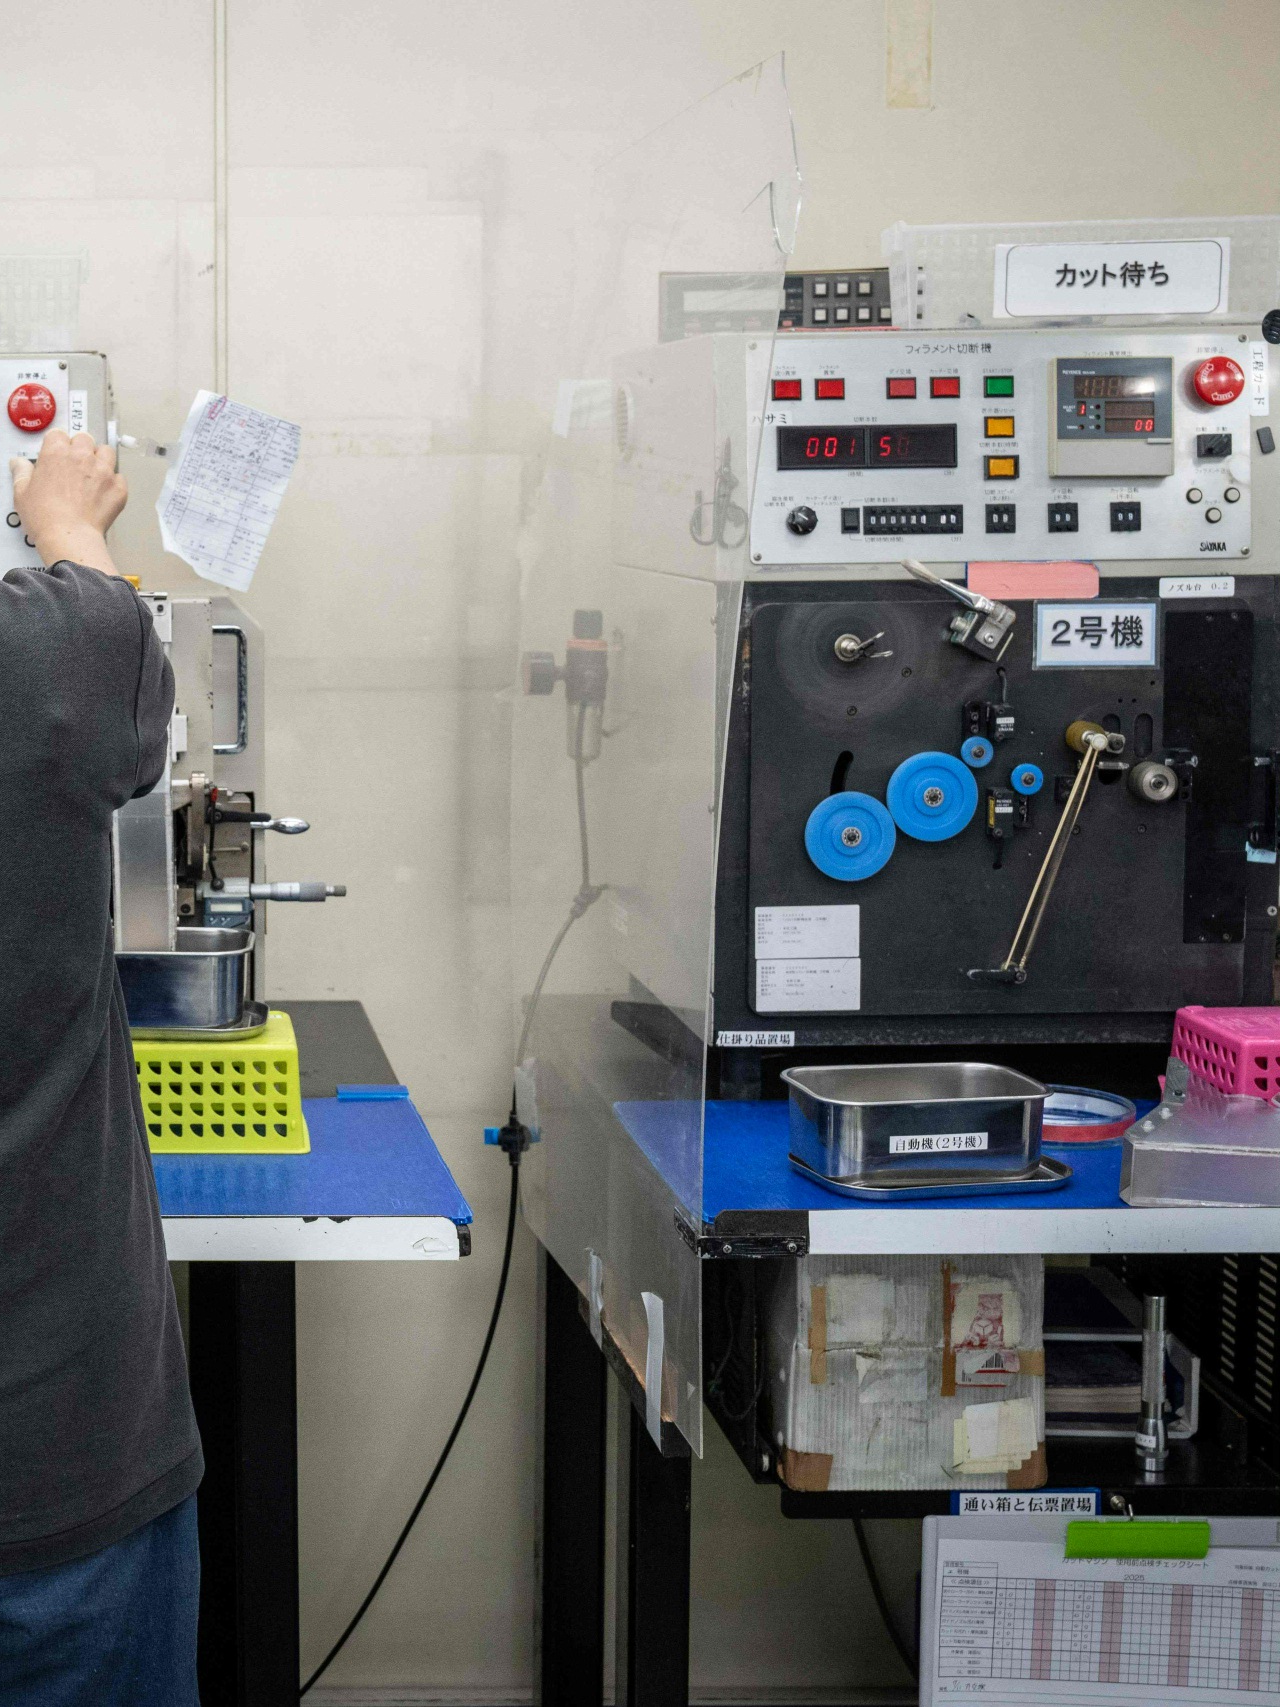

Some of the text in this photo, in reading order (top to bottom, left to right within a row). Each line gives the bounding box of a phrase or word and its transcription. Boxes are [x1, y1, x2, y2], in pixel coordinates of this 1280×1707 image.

[1054, 260, 1170, 289] カット待ち
[904, 343, 992, 354] フィラメント切断機
[752, 412, 788, 425] ハサミ
[1199, 542, 1227, 552] SAYAKA
[1167, 582, 1229, 592] ノズル台 0.2
[1051, 614, 1144, 648] 2号機
[719, 1033, 791, 1045] 仕掛り品置場
[895, 1135, 984, 1151] 自動機(2号機)
[964, 1496, 1093, 1514] 通い箱と伝票置場
[1123, 1573, 1146, 1582] 2025
